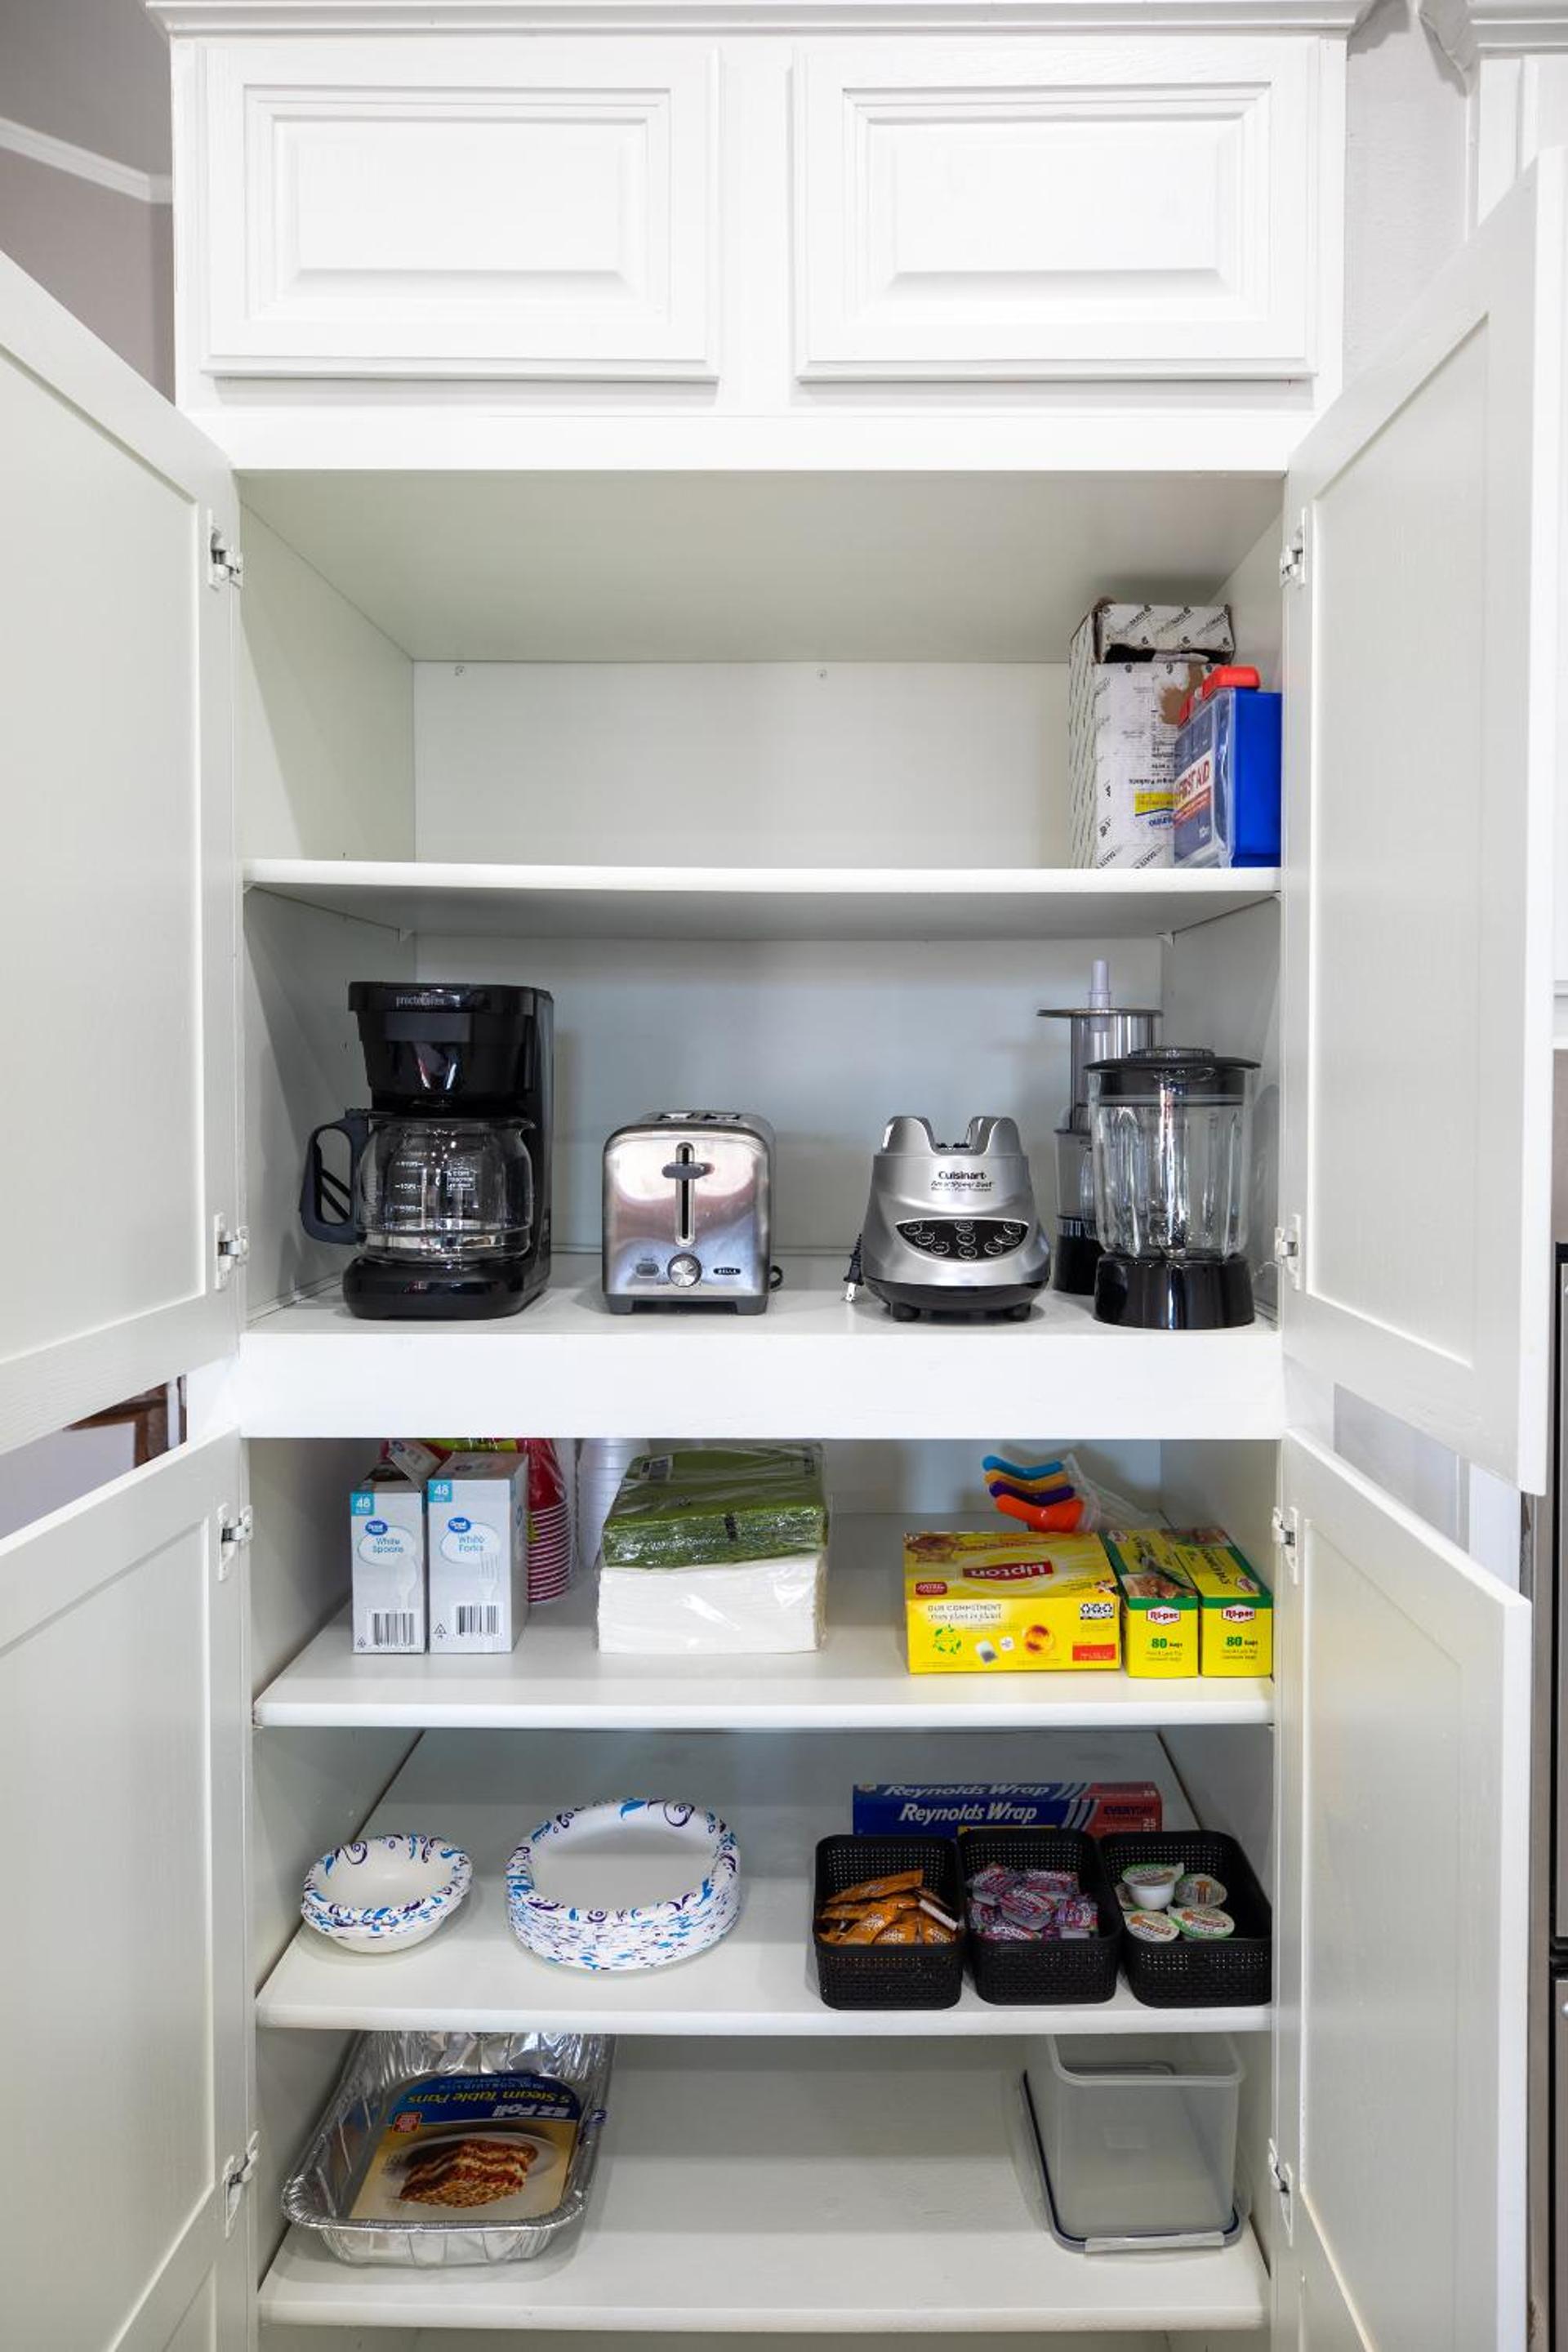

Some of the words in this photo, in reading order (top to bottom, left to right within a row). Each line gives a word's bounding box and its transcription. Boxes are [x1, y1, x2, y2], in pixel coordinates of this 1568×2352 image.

[938, 1170, 984, 1180] Cuisinart
[434, 1484, 449, 1495] 48
[356, 1496, 371, 1508] 48
[969, 1563, 1047, 1578] Lipton
[1152, 1638, 1167, 1648] 80
[1227, 1637, 1242, 1646] 80
[884, 1784, 985, 1797] Reynolds
[990, 1784, 1050, 1797] Wrap
[899, 1803, 985, 1826] Reynolds
[987, 1803, 1038, 1824] Wrap
[1143, 1818, 1156, 1828] 25
[407, 2093, 450, 2105] Pans
[502, 2091, 558, 2102] Steam
